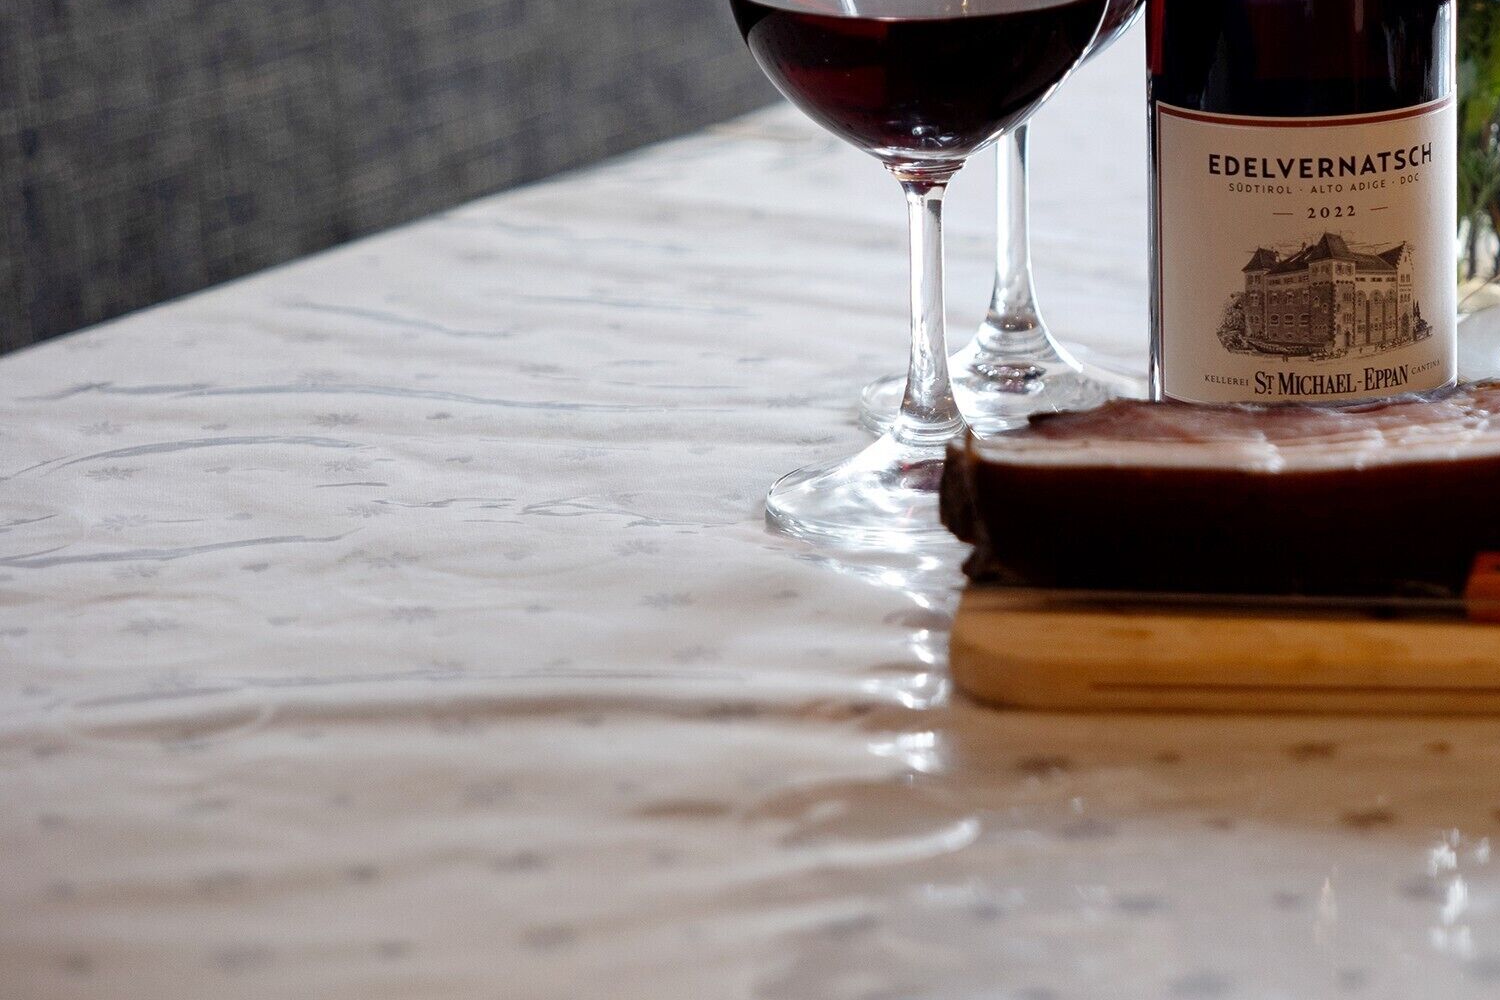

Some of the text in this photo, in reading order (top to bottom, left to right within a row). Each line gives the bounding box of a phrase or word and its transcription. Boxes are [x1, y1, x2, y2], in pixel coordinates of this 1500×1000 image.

[1208, 142, 1432, 179] EDELVERNATSCH
[1228, 173, 1419, 194] SÜDTIROL ALTO ADIGE DOC
[1307, 205, 1356, 219] 2022
[1204, 374, 1249, 386] KELLEREI
[1411, 359, 1440, 375] CANTINA
